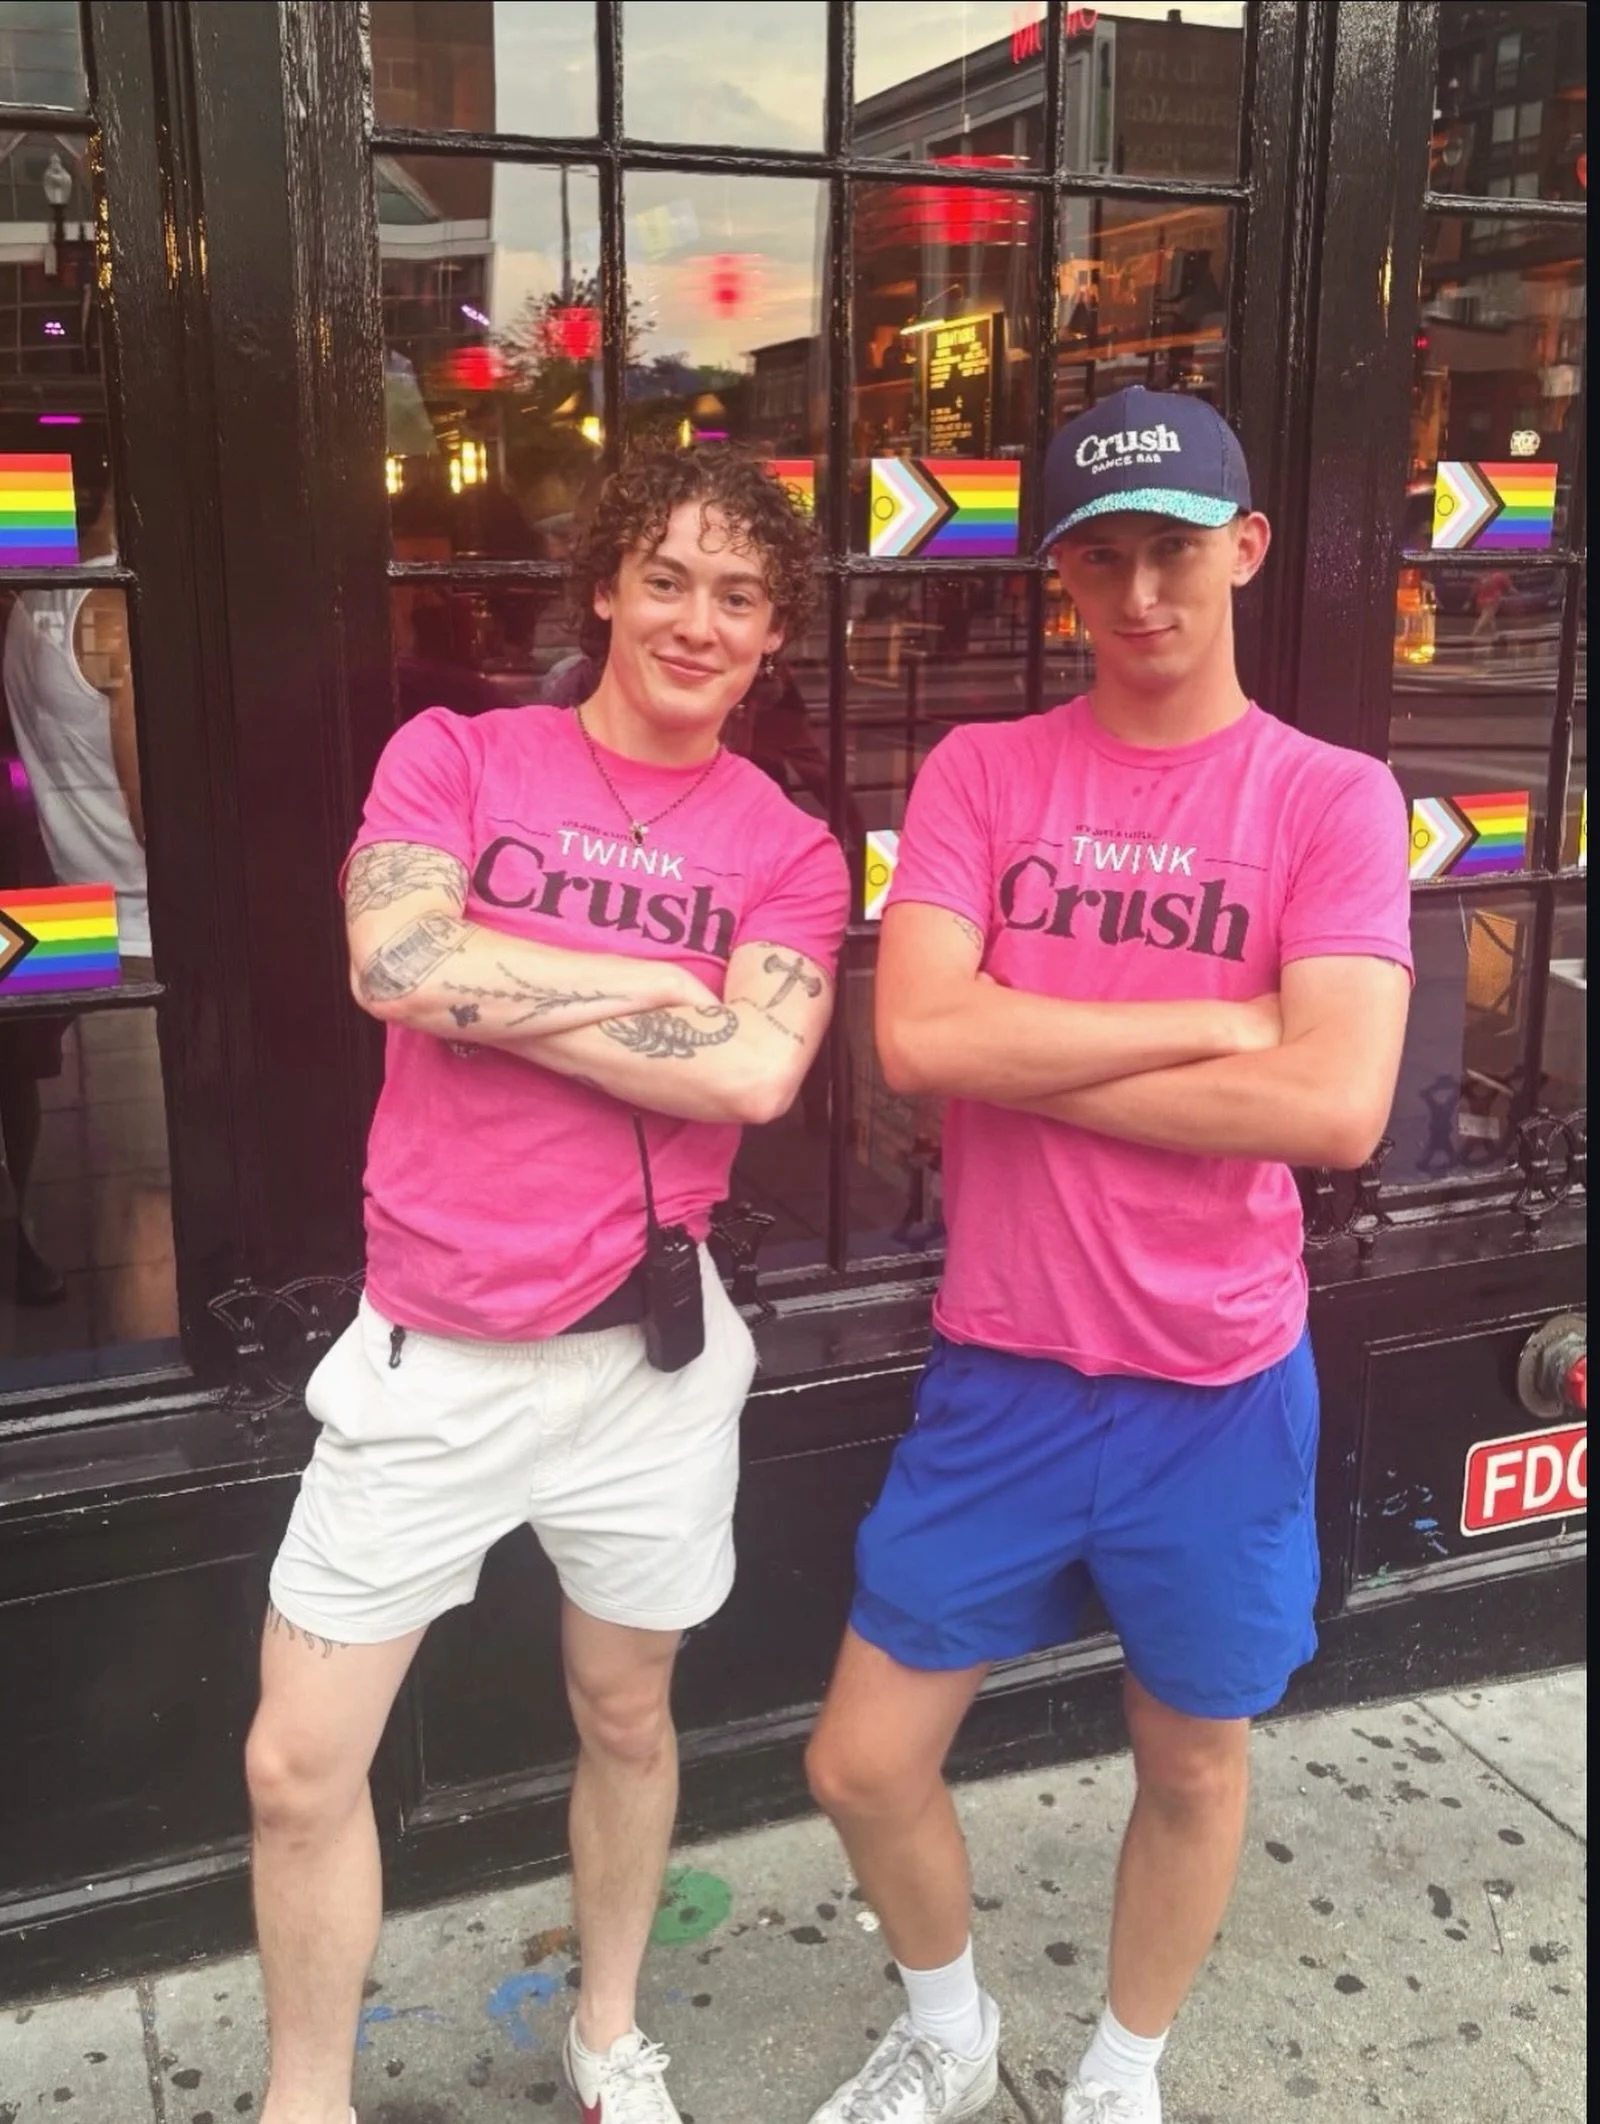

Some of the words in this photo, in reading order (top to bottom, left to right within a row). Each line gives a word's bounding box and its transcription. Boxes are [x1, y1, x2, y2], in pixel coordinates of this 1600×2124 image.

[1075, 423, 1181, 467] Crush
[1091, 455, 1133, 475] DANCE
[1136, 453, 1162, 464] BAR
[558, 829, 685, 880] TWINK
[1072, 835, 1197, 876] TWINK
[473, 836, 736, 960] Crush
[999, 855, 1250, 962] Crush
